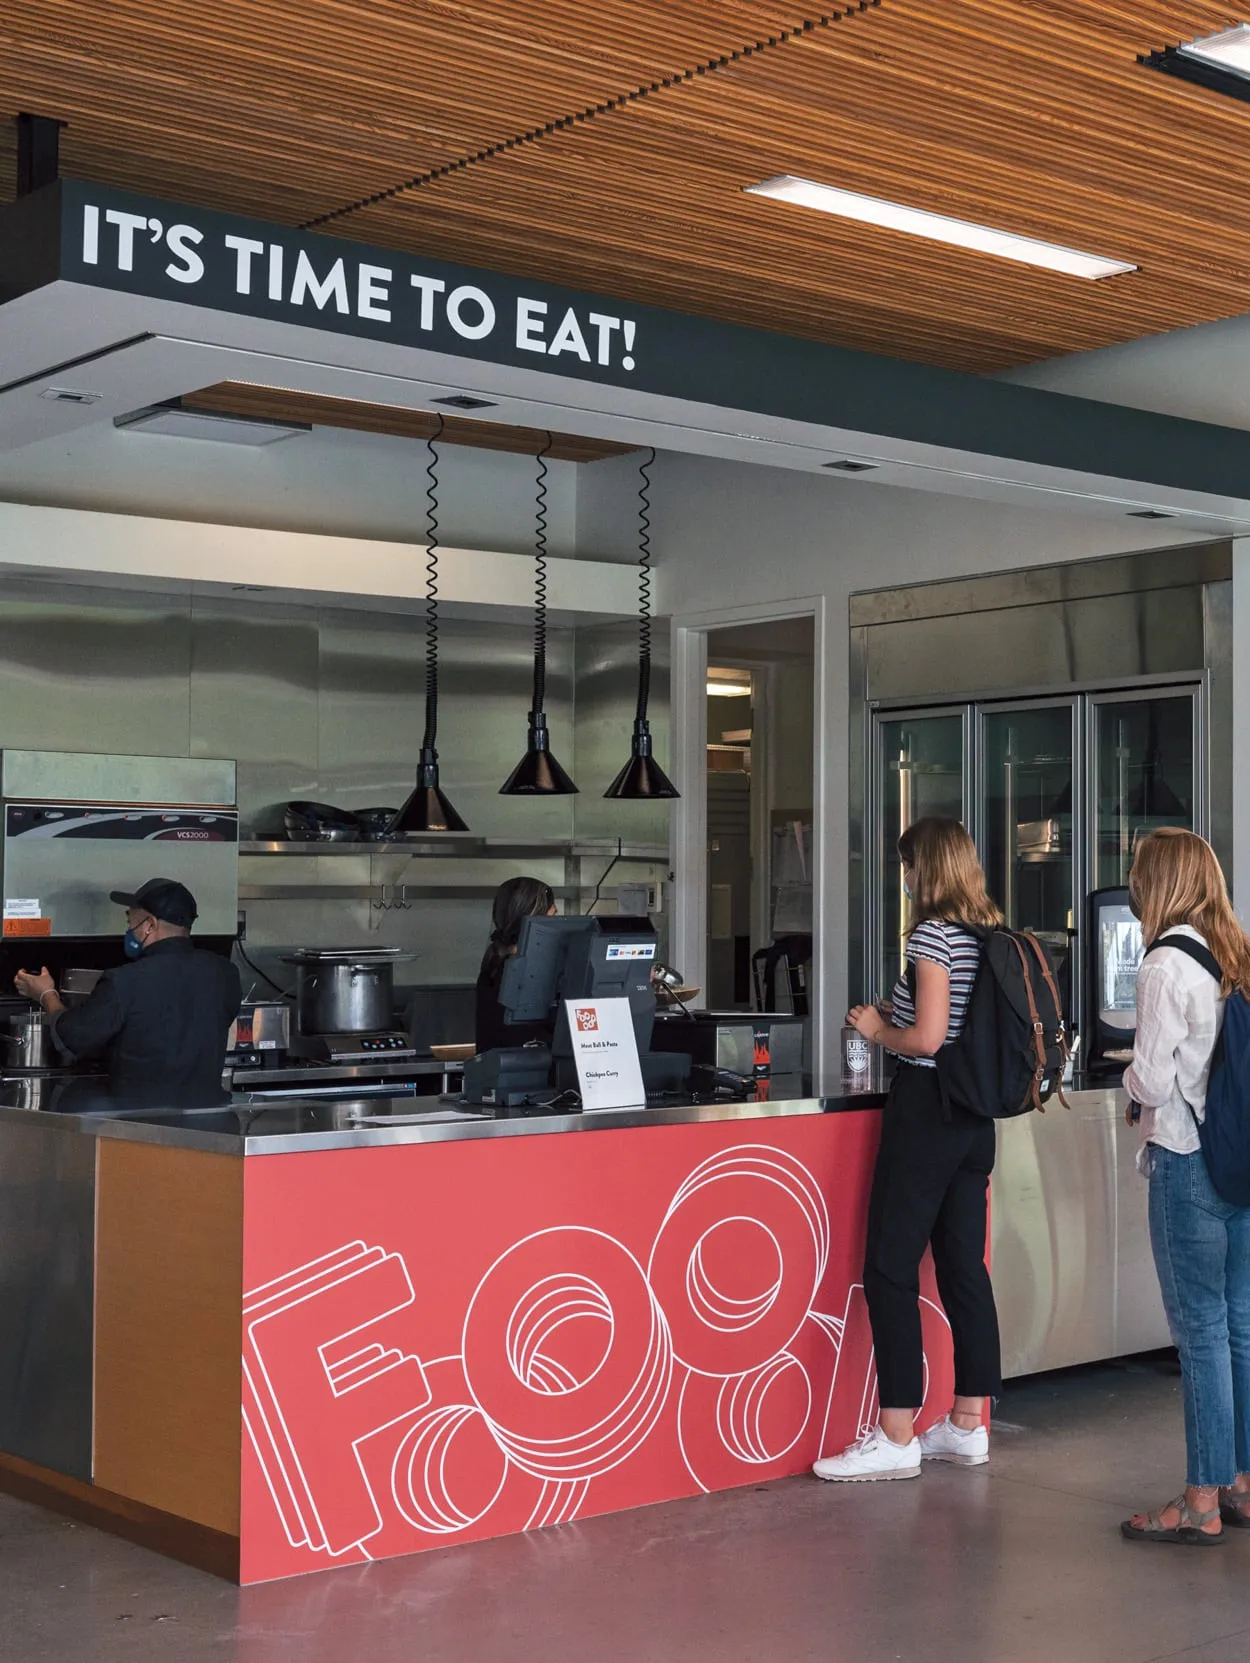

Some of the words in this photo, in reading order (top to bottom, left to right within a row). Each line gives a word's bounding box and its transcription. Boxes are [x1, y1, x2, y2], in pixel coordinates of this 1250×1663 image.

[83, 204, 204, 283] IT'S
[225, 233, 392, 323] TIME
[410, 274, 496, 341] TO
[516, 297, 636, 371] EAT!
[177, 830, 209, 840] VCS2000
[848, 1041, 868, 1050] UBC
